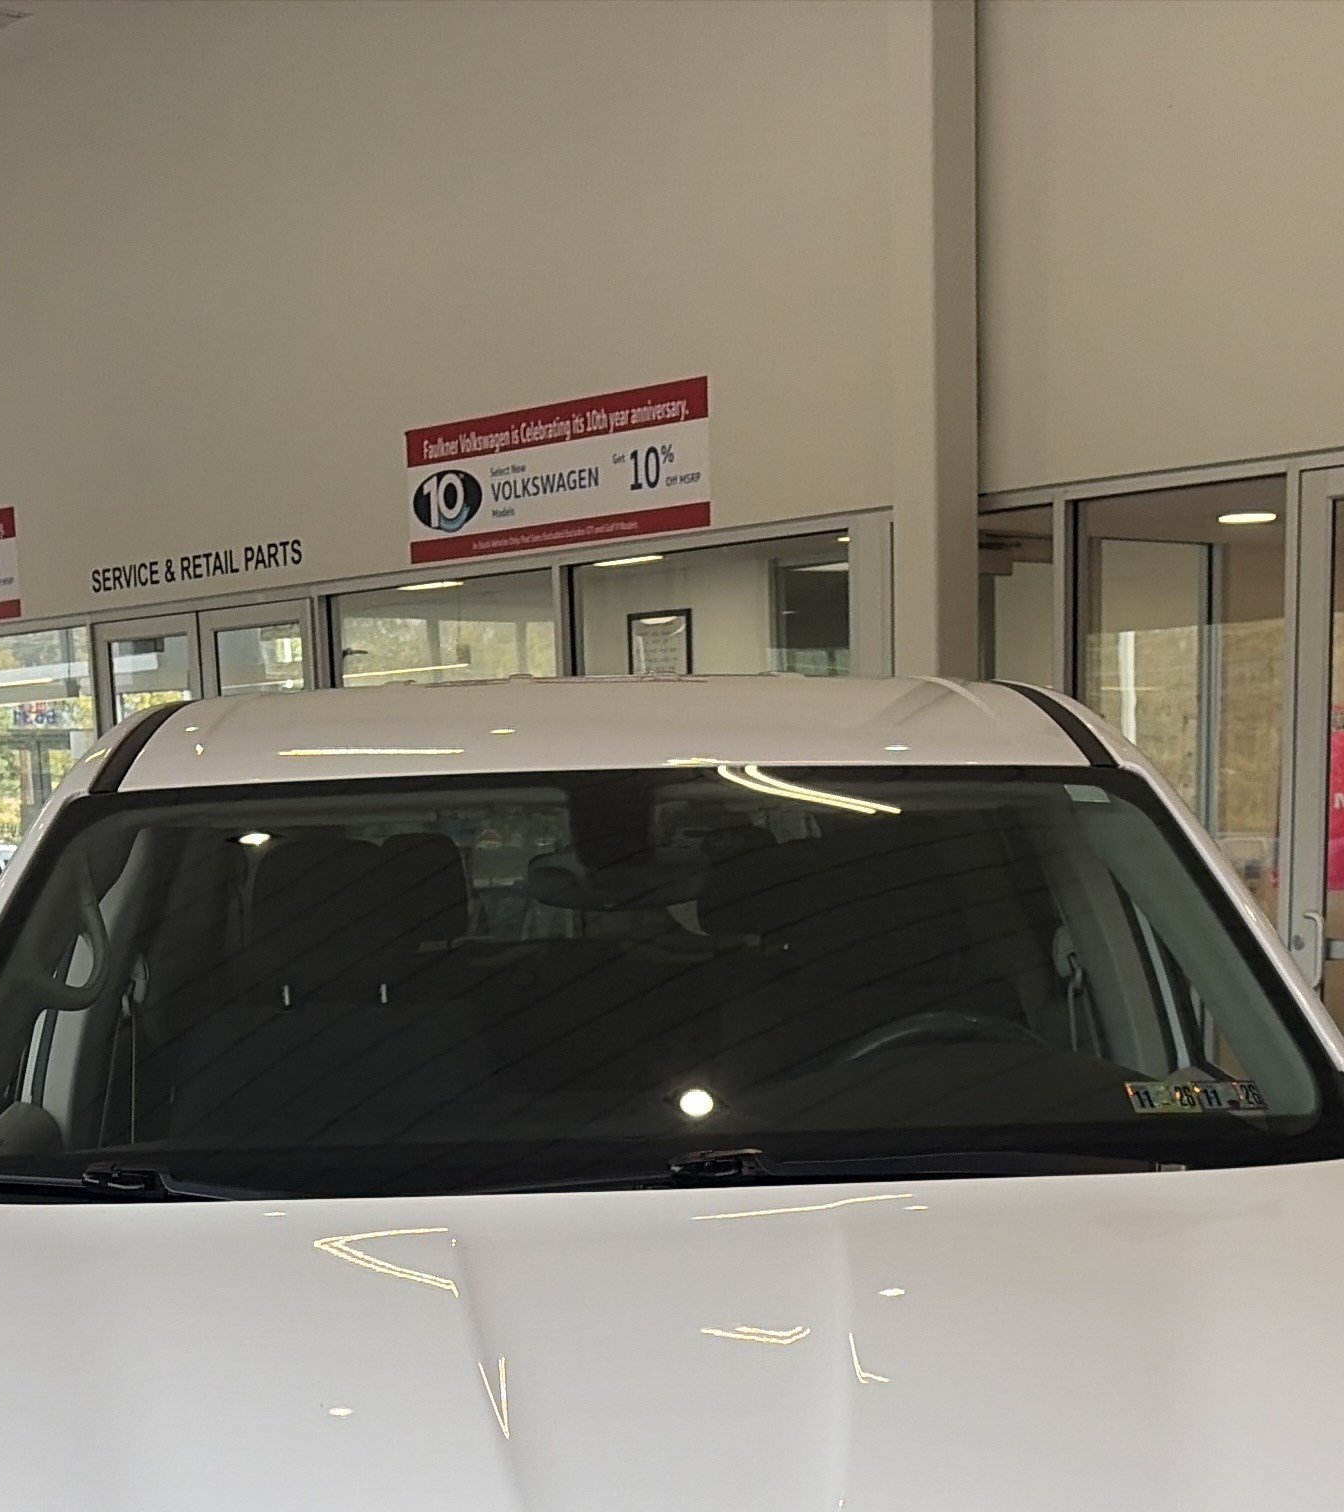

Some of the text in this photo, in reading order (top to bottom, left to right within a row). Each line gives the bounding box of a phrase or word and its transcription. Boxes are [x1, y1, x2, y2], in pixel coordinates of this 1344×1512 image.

[458, 430, 511, 454] Volkswagen
[511, 423, 519, 445] is
[519, 415, 572, 443] Celebrating
[585, 407, 609, 432] 10th
[608, 409, 630, 434] year
[491, 466, 600, 502] VOLKSWAGEN
[91, 538, 303, 593] SERVICE & RETAIL PARTS
